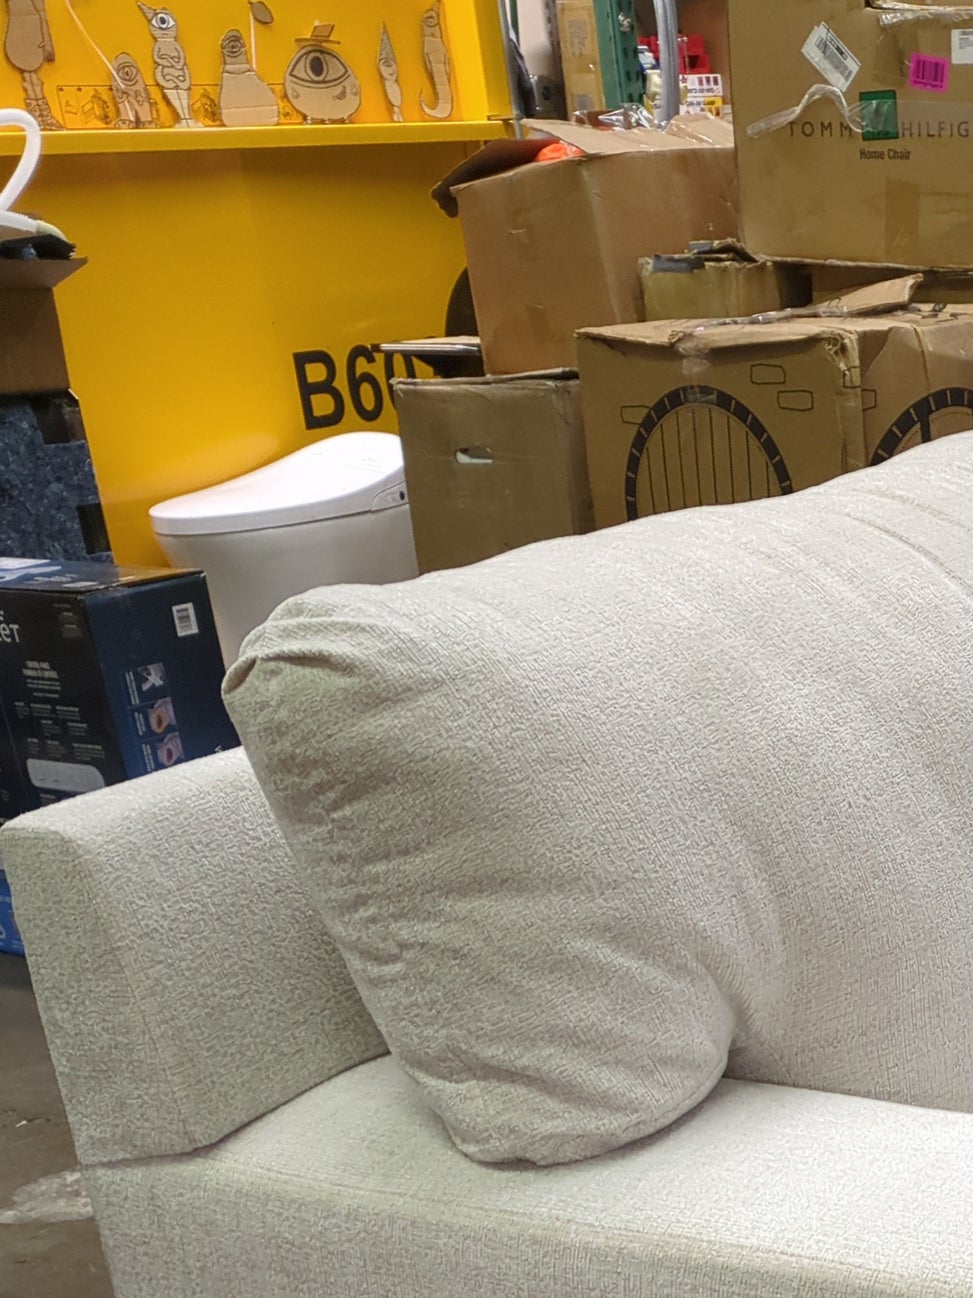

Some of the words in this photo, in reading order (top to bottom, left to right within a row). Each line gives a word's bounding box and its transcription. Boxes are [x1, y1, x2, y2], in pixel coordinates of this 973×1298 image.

[788, 120, 862, 138] TOMM
[859, 148, 886, 160] Home
[887, 148, 911, 161] Chair
